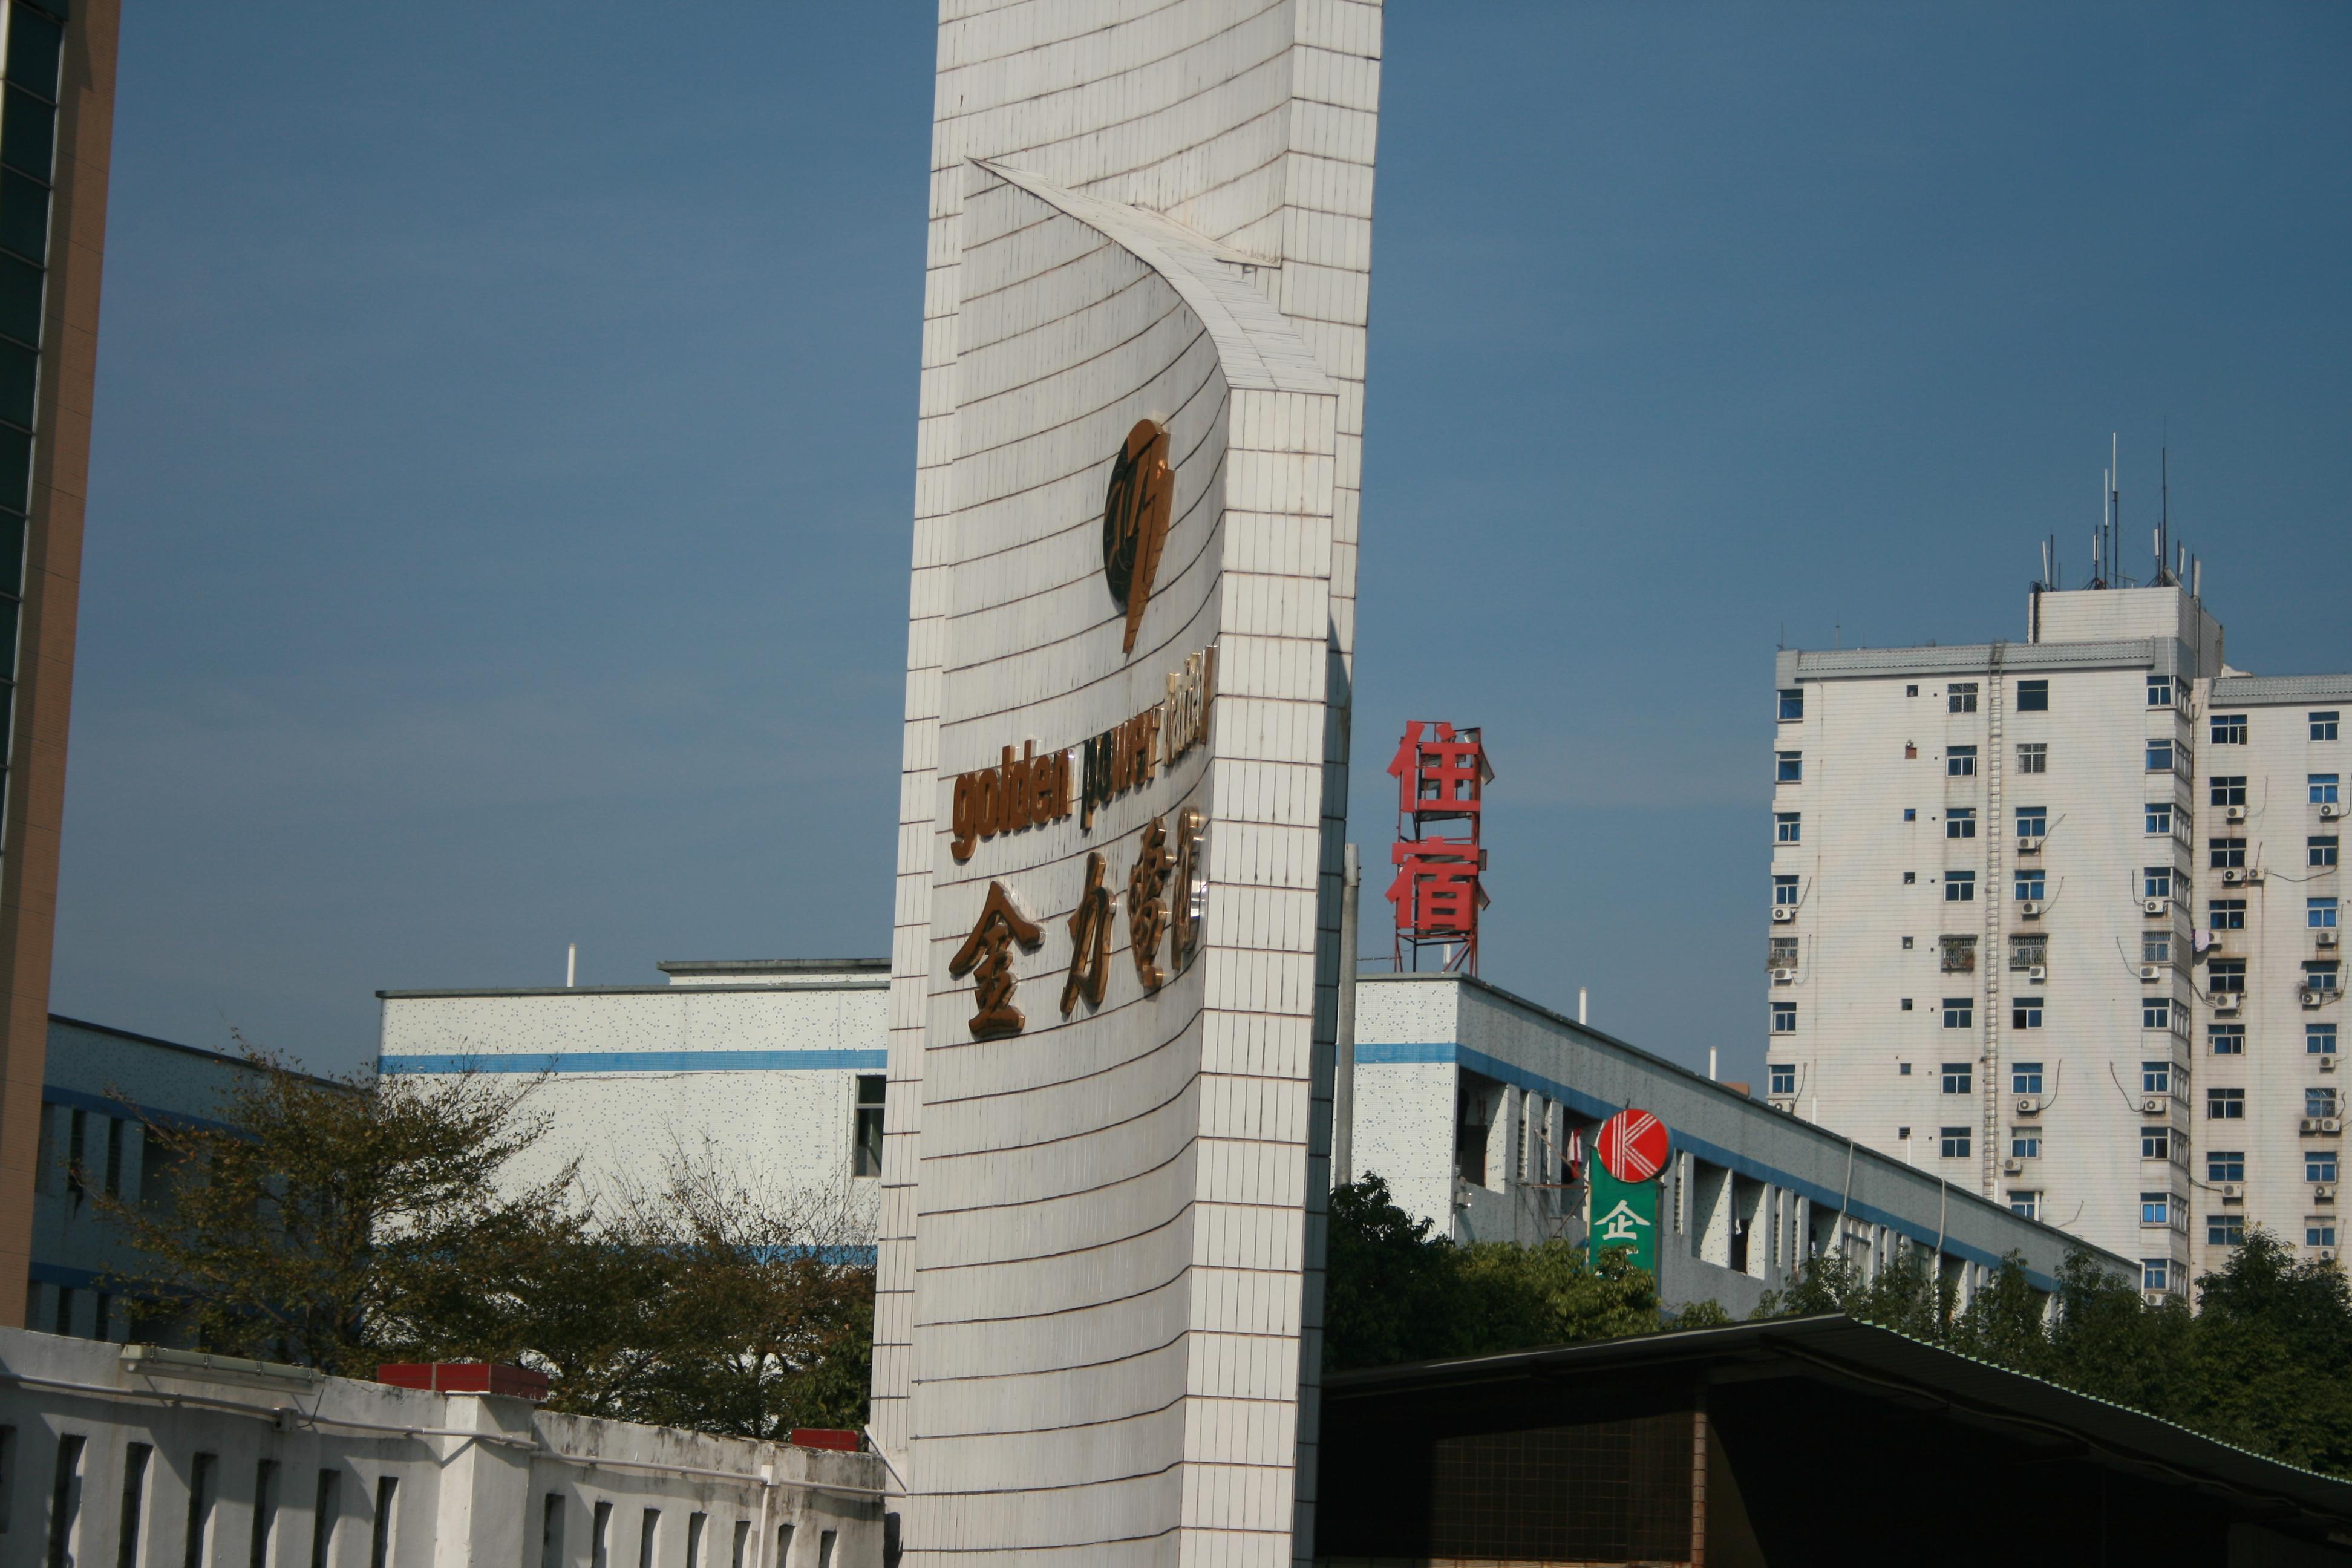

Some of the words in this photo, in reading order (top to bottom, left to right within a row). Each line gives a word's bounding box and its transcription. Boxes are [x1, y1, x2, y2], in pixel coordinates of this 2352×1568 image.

[950, 739, 1075, 860] golden
[1080, 708, 1162, 830] power
[1385, 720, 1480, 930] 住宿
